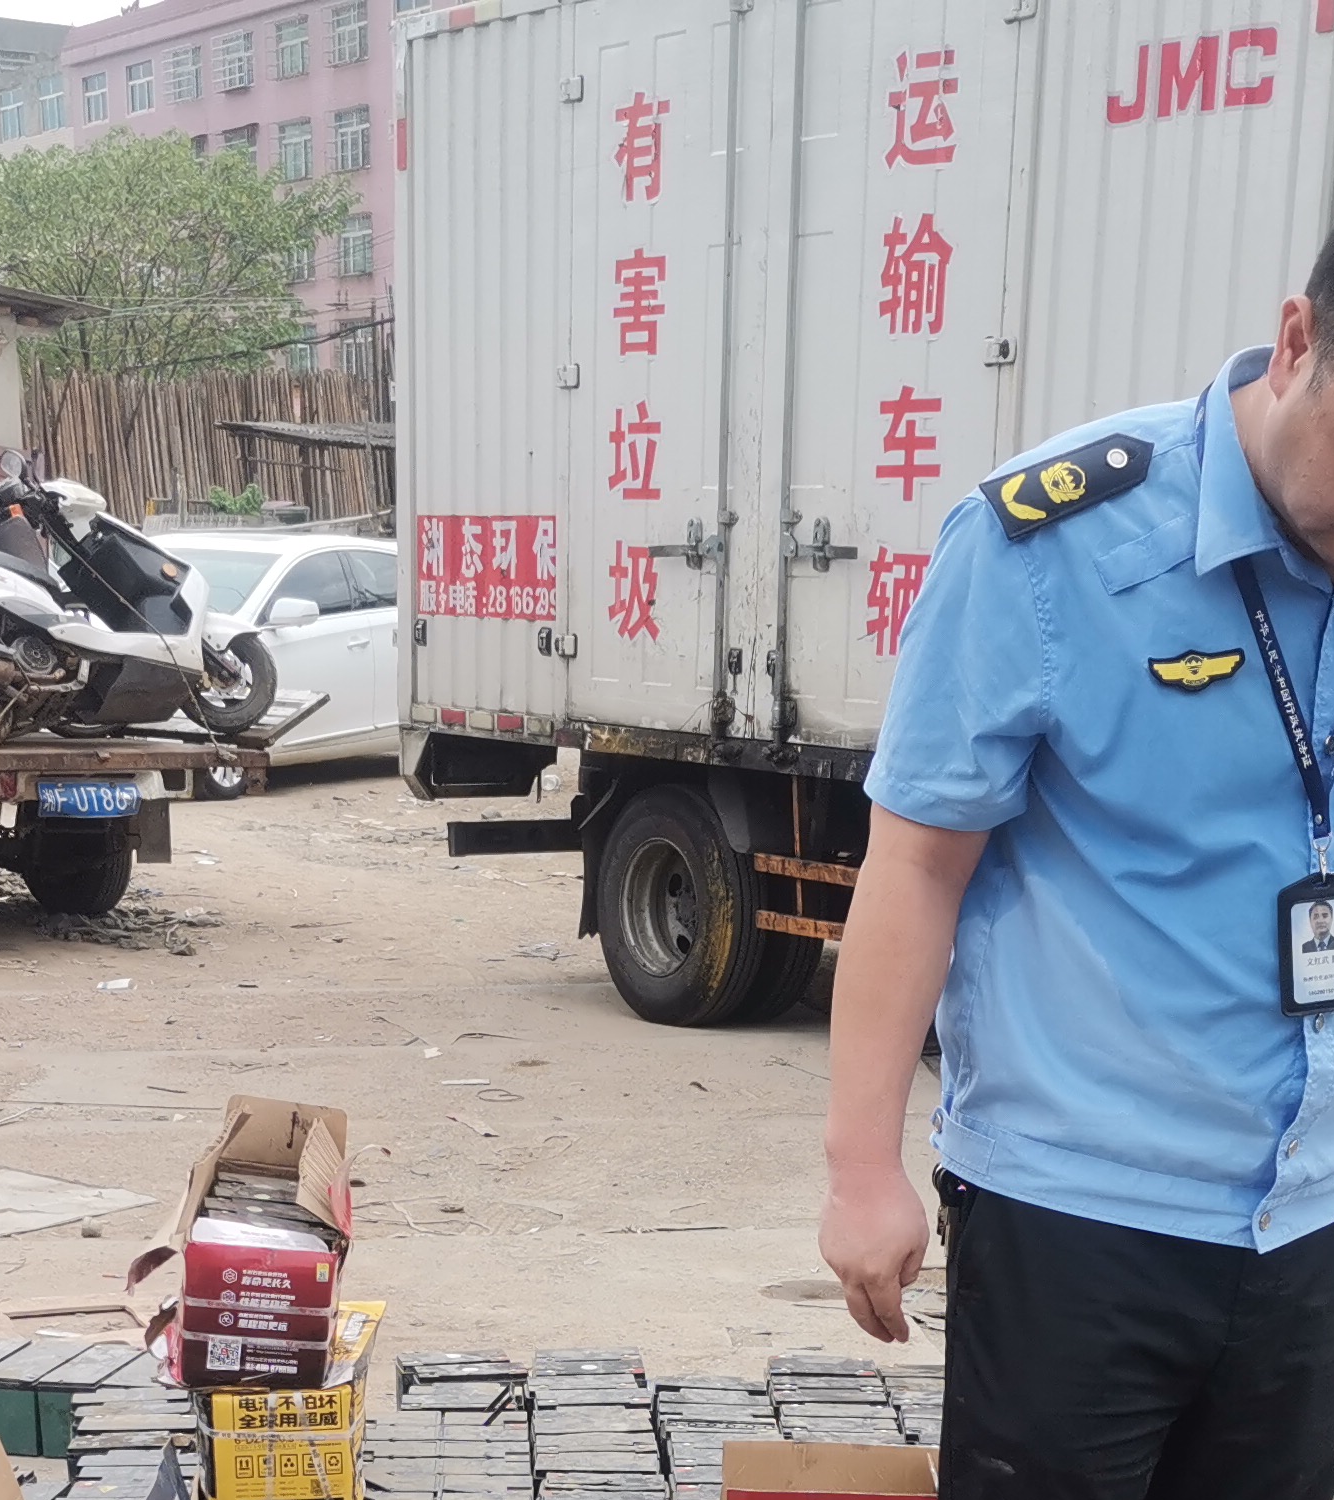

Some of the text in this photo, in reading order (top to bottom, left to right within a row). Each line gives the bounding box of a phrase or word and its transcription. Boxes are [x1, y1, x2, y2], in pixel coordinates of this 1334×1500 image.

[1107, 27, 1278, 124] JMC
[608, 92, 670, 642] 有害垃圾
[1255, 610, 1312, 769] 中华人民共和国行政执法证
